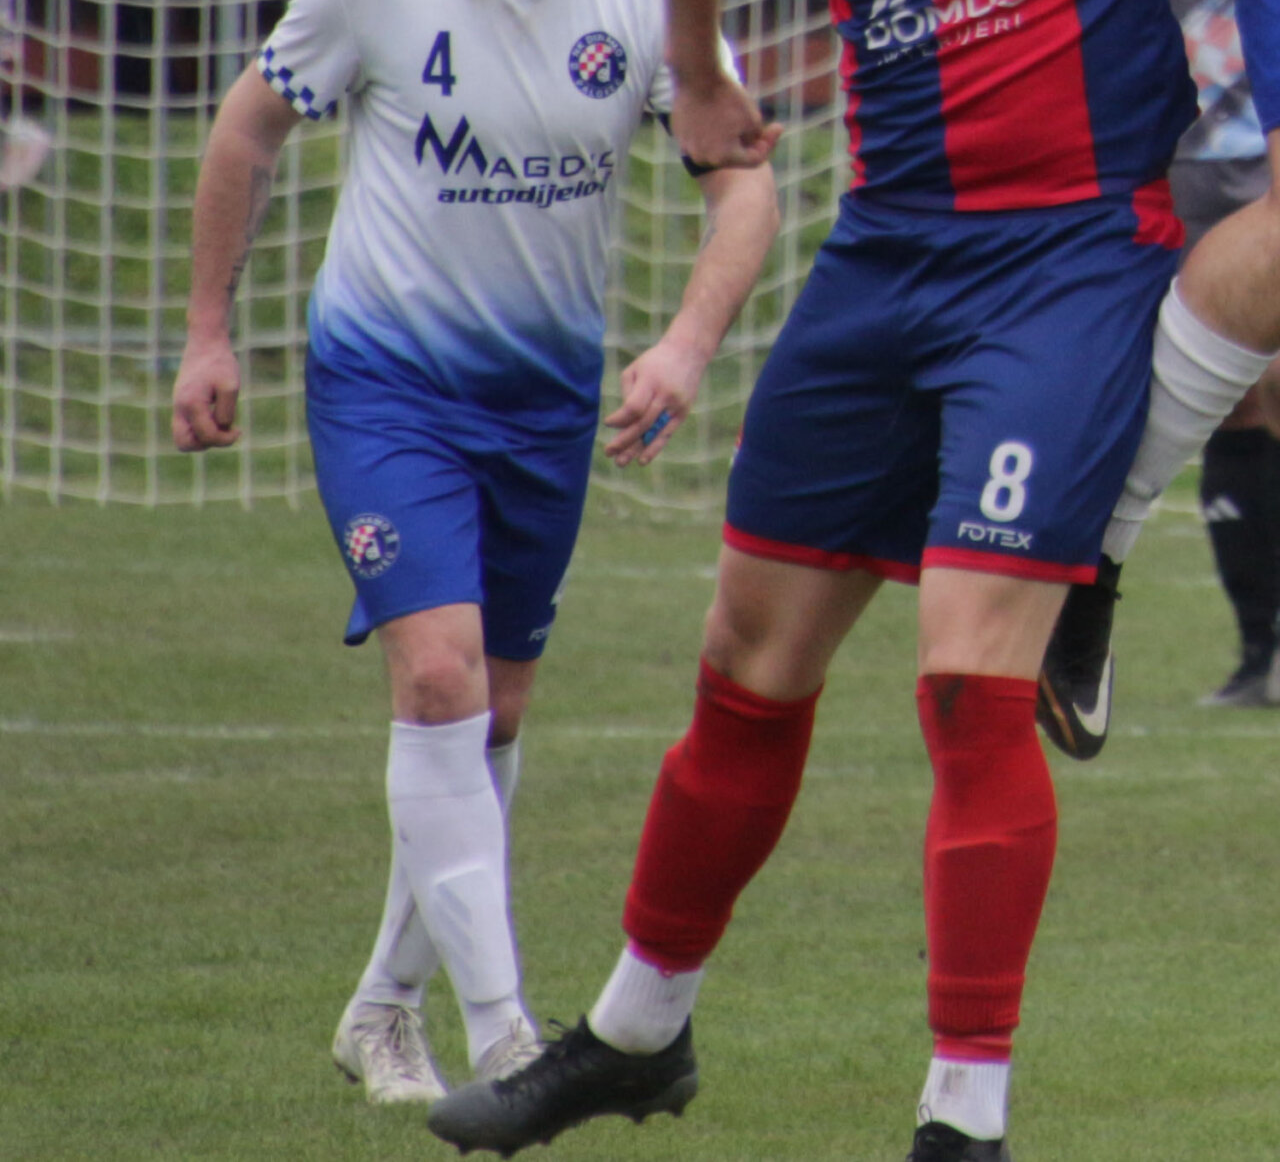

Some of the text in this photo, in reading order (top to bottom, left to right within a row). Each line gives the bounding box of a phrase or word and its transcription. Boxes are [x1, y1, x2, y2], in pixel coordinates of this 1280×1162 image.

[421, 30, 457, 97] 4
[980, 442, 1033, 523] 8
[957, 522, 1033, 550] FOTEX
